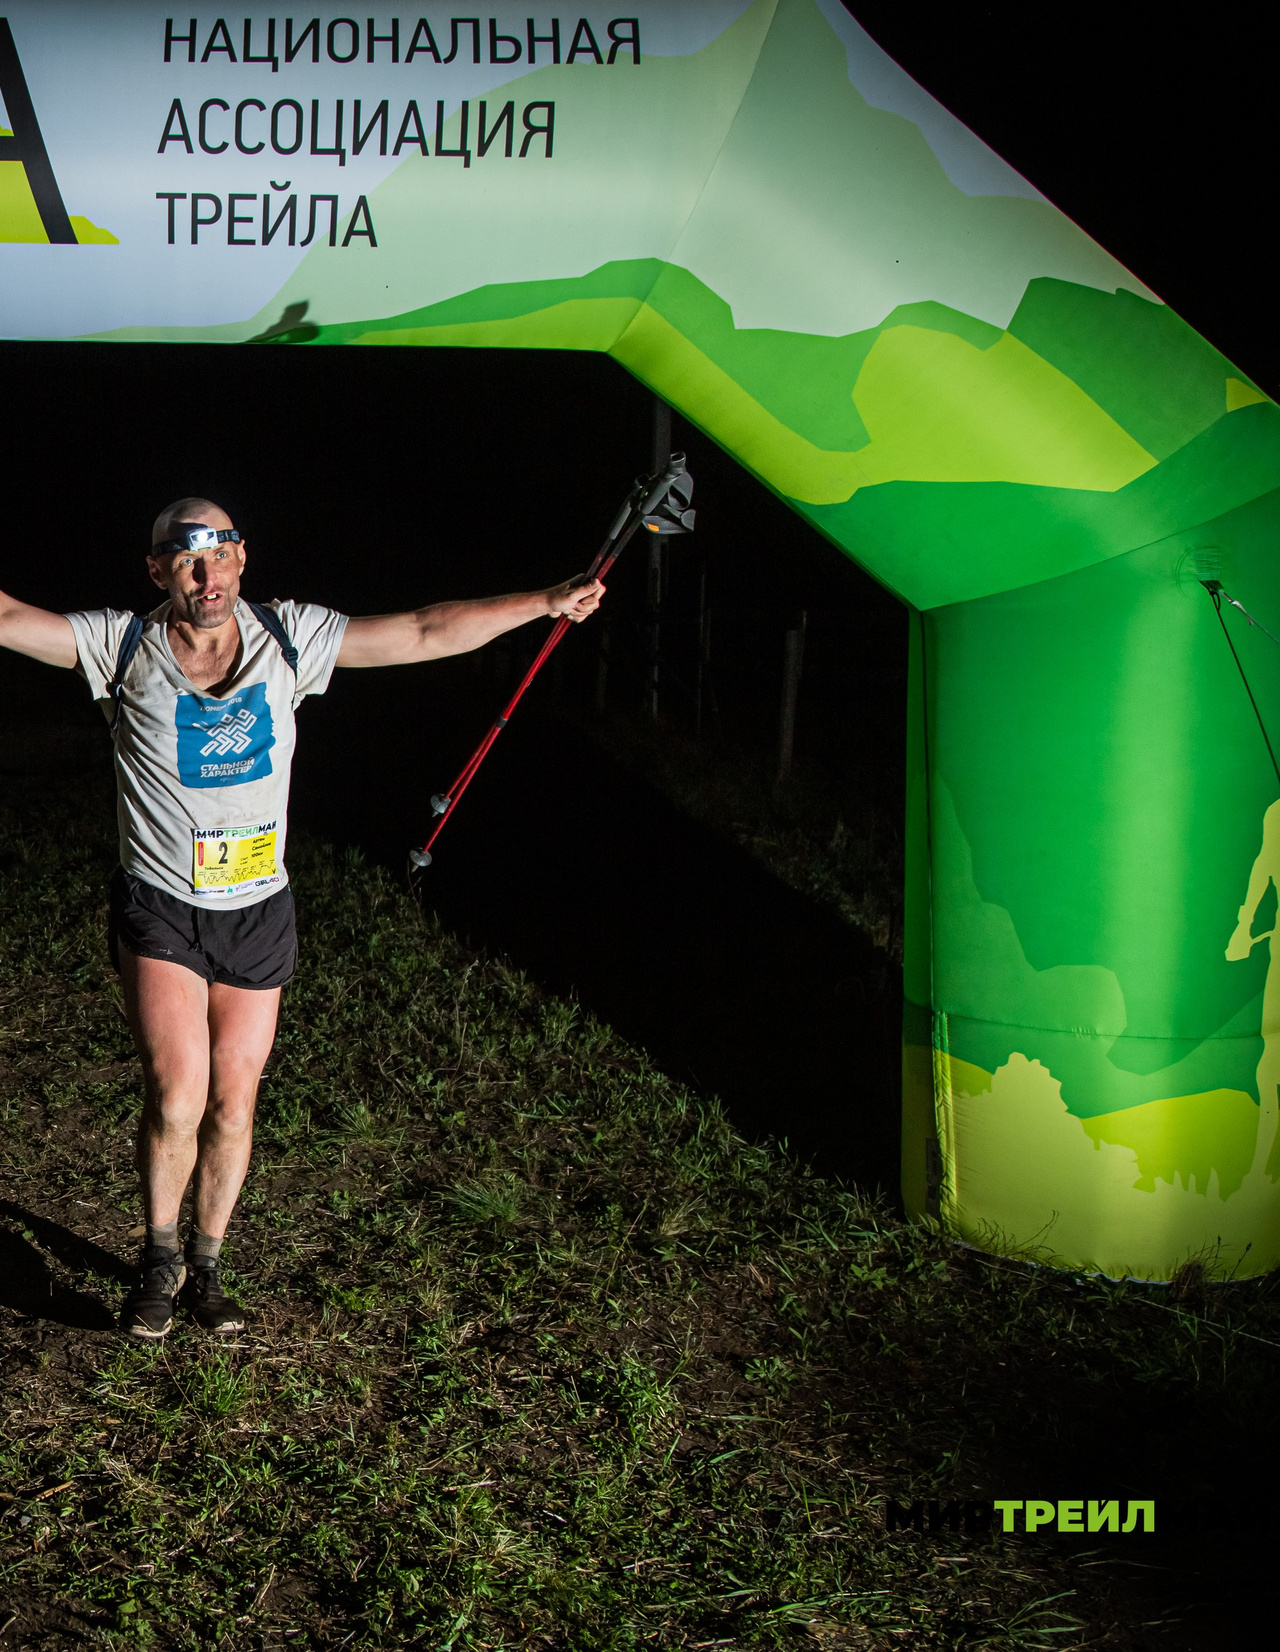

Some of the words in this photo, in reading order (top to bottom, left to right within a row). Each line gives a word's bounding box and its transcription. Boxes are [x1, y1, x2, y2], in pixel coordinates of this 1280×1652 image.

[163, 18, 641, 72] НАЦИОНАЛЬНАЯ
[157, 98, 556, 168] АССОЦИАЦИЯ
[156, 181, 378, 247] ТРЕЙЛА
[200, 757, 255, 771] СТАЛЬНОЙ
[200, 766, 252, 778] ХАРАКТЕР
[218, 842, 229, 865] 2
